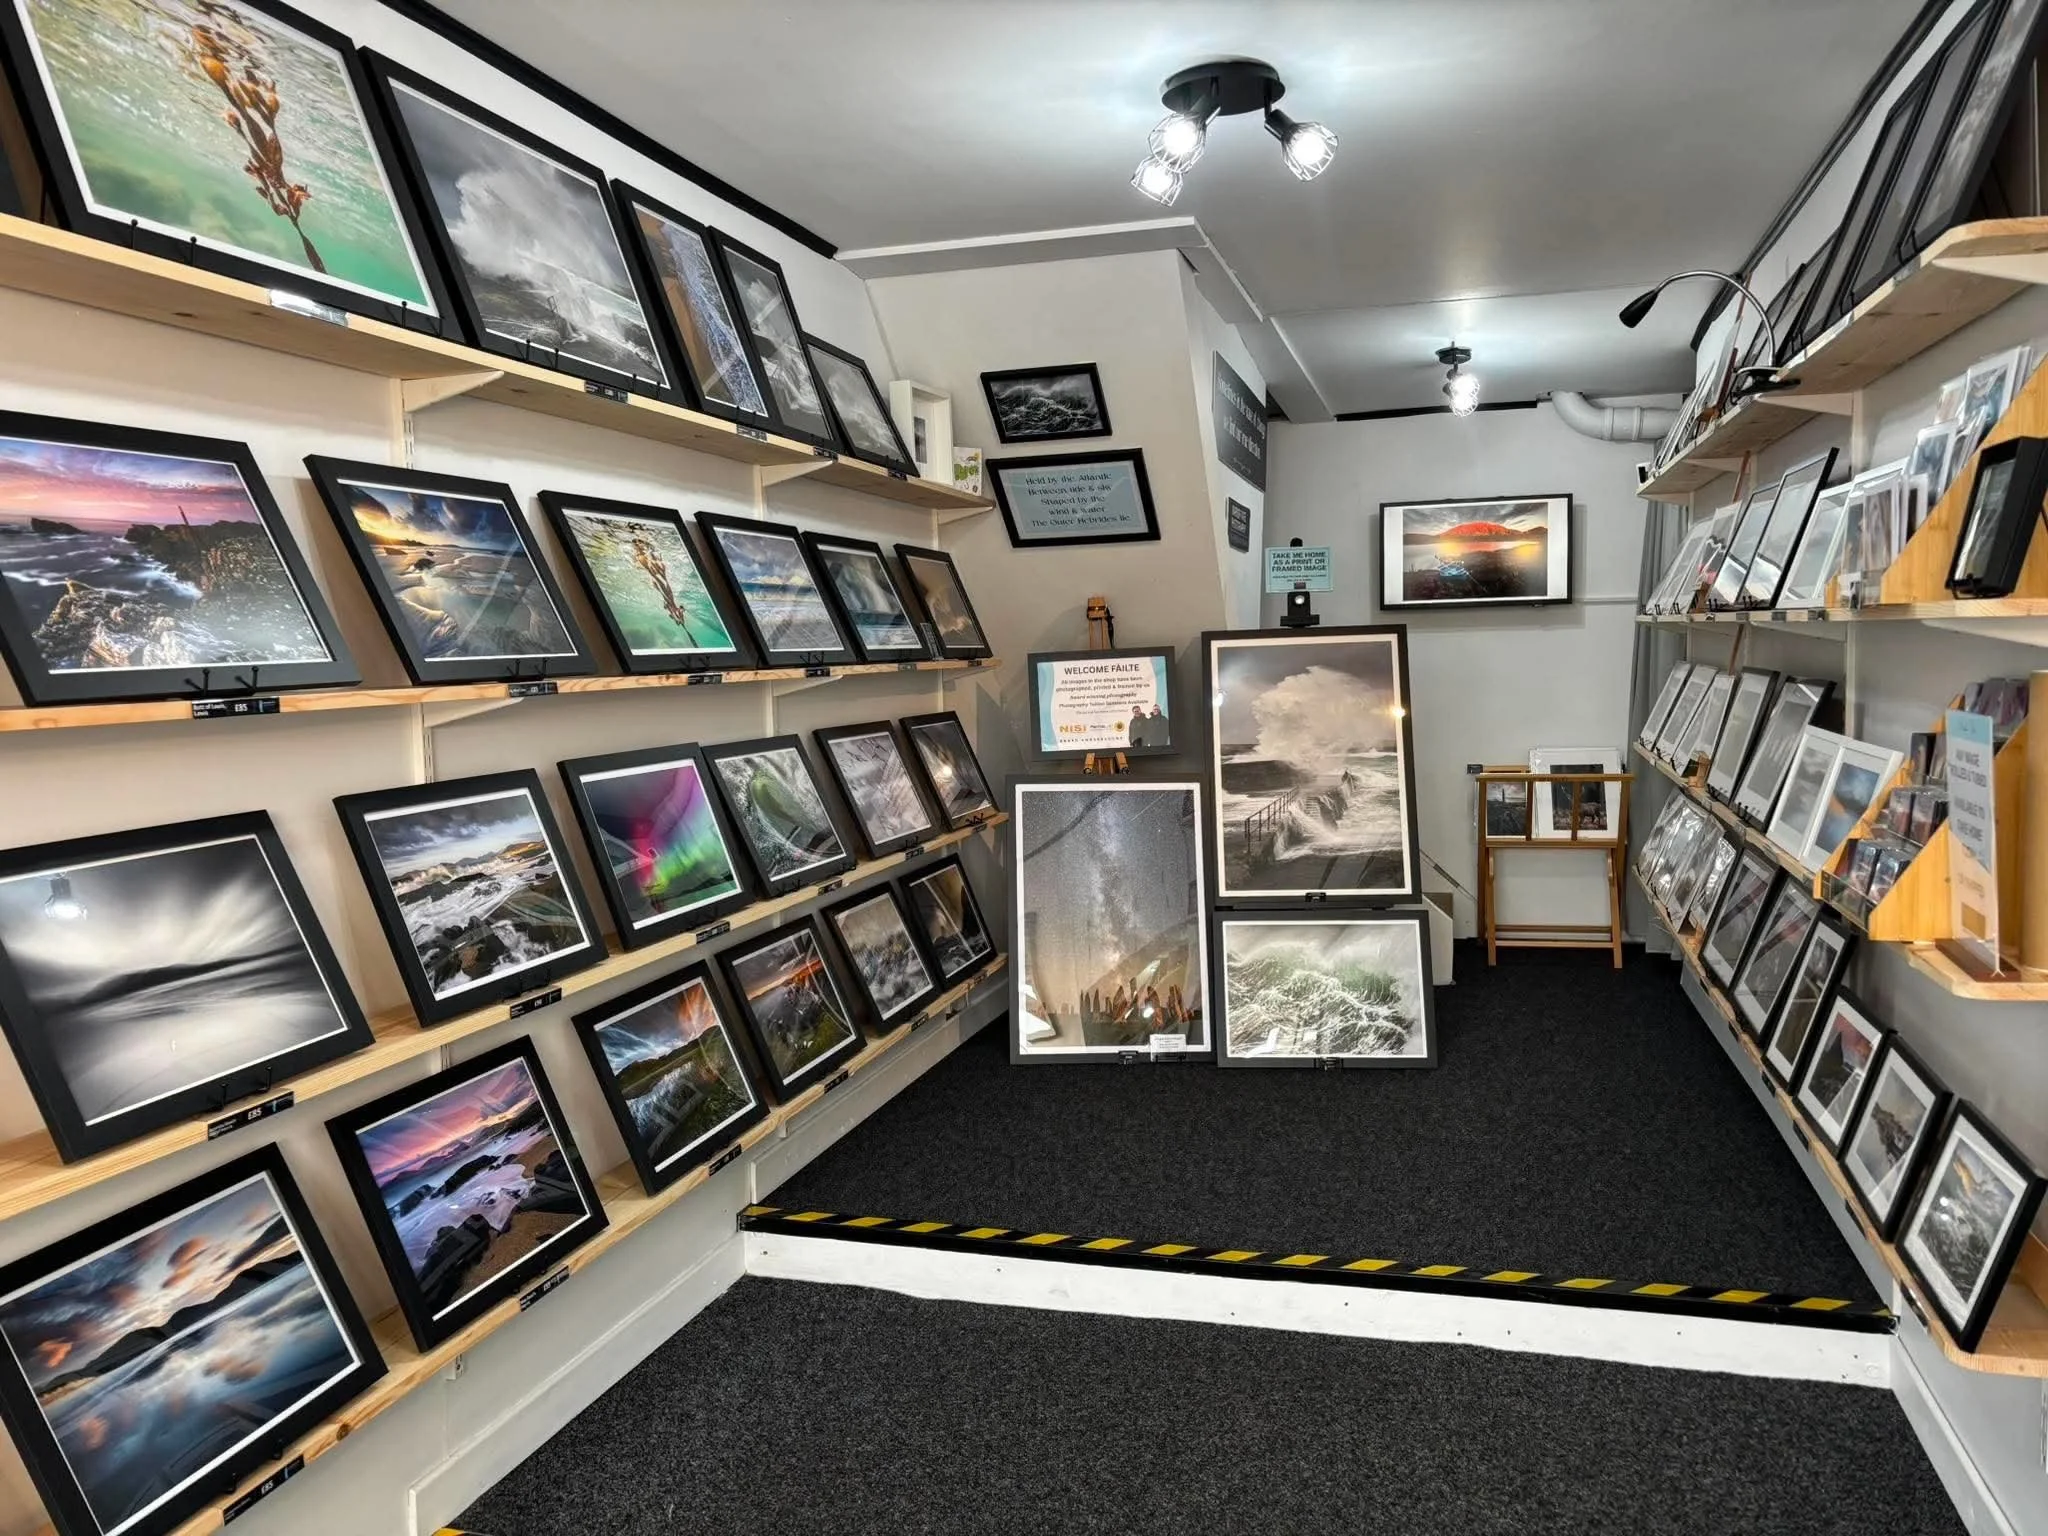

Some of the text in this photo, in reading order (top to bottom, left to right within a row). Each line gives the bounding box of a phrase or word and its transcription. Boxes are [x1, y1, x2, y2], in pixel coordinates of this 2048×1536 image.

[1026, 477, 1046, 485] Held
[1048, 477, 1057, 485] by
[1061, 475, 1075, 483] the
[1077, 496, 1088, 504] by
[1090, 495, 1105, 503] the
[1050, 518, 1074, 526] Outer
[1077, 516, 1117, 525] Hebrides
[1064, 665, 1109, 675] WELCOME
[234, 703, 248, 712] £85
